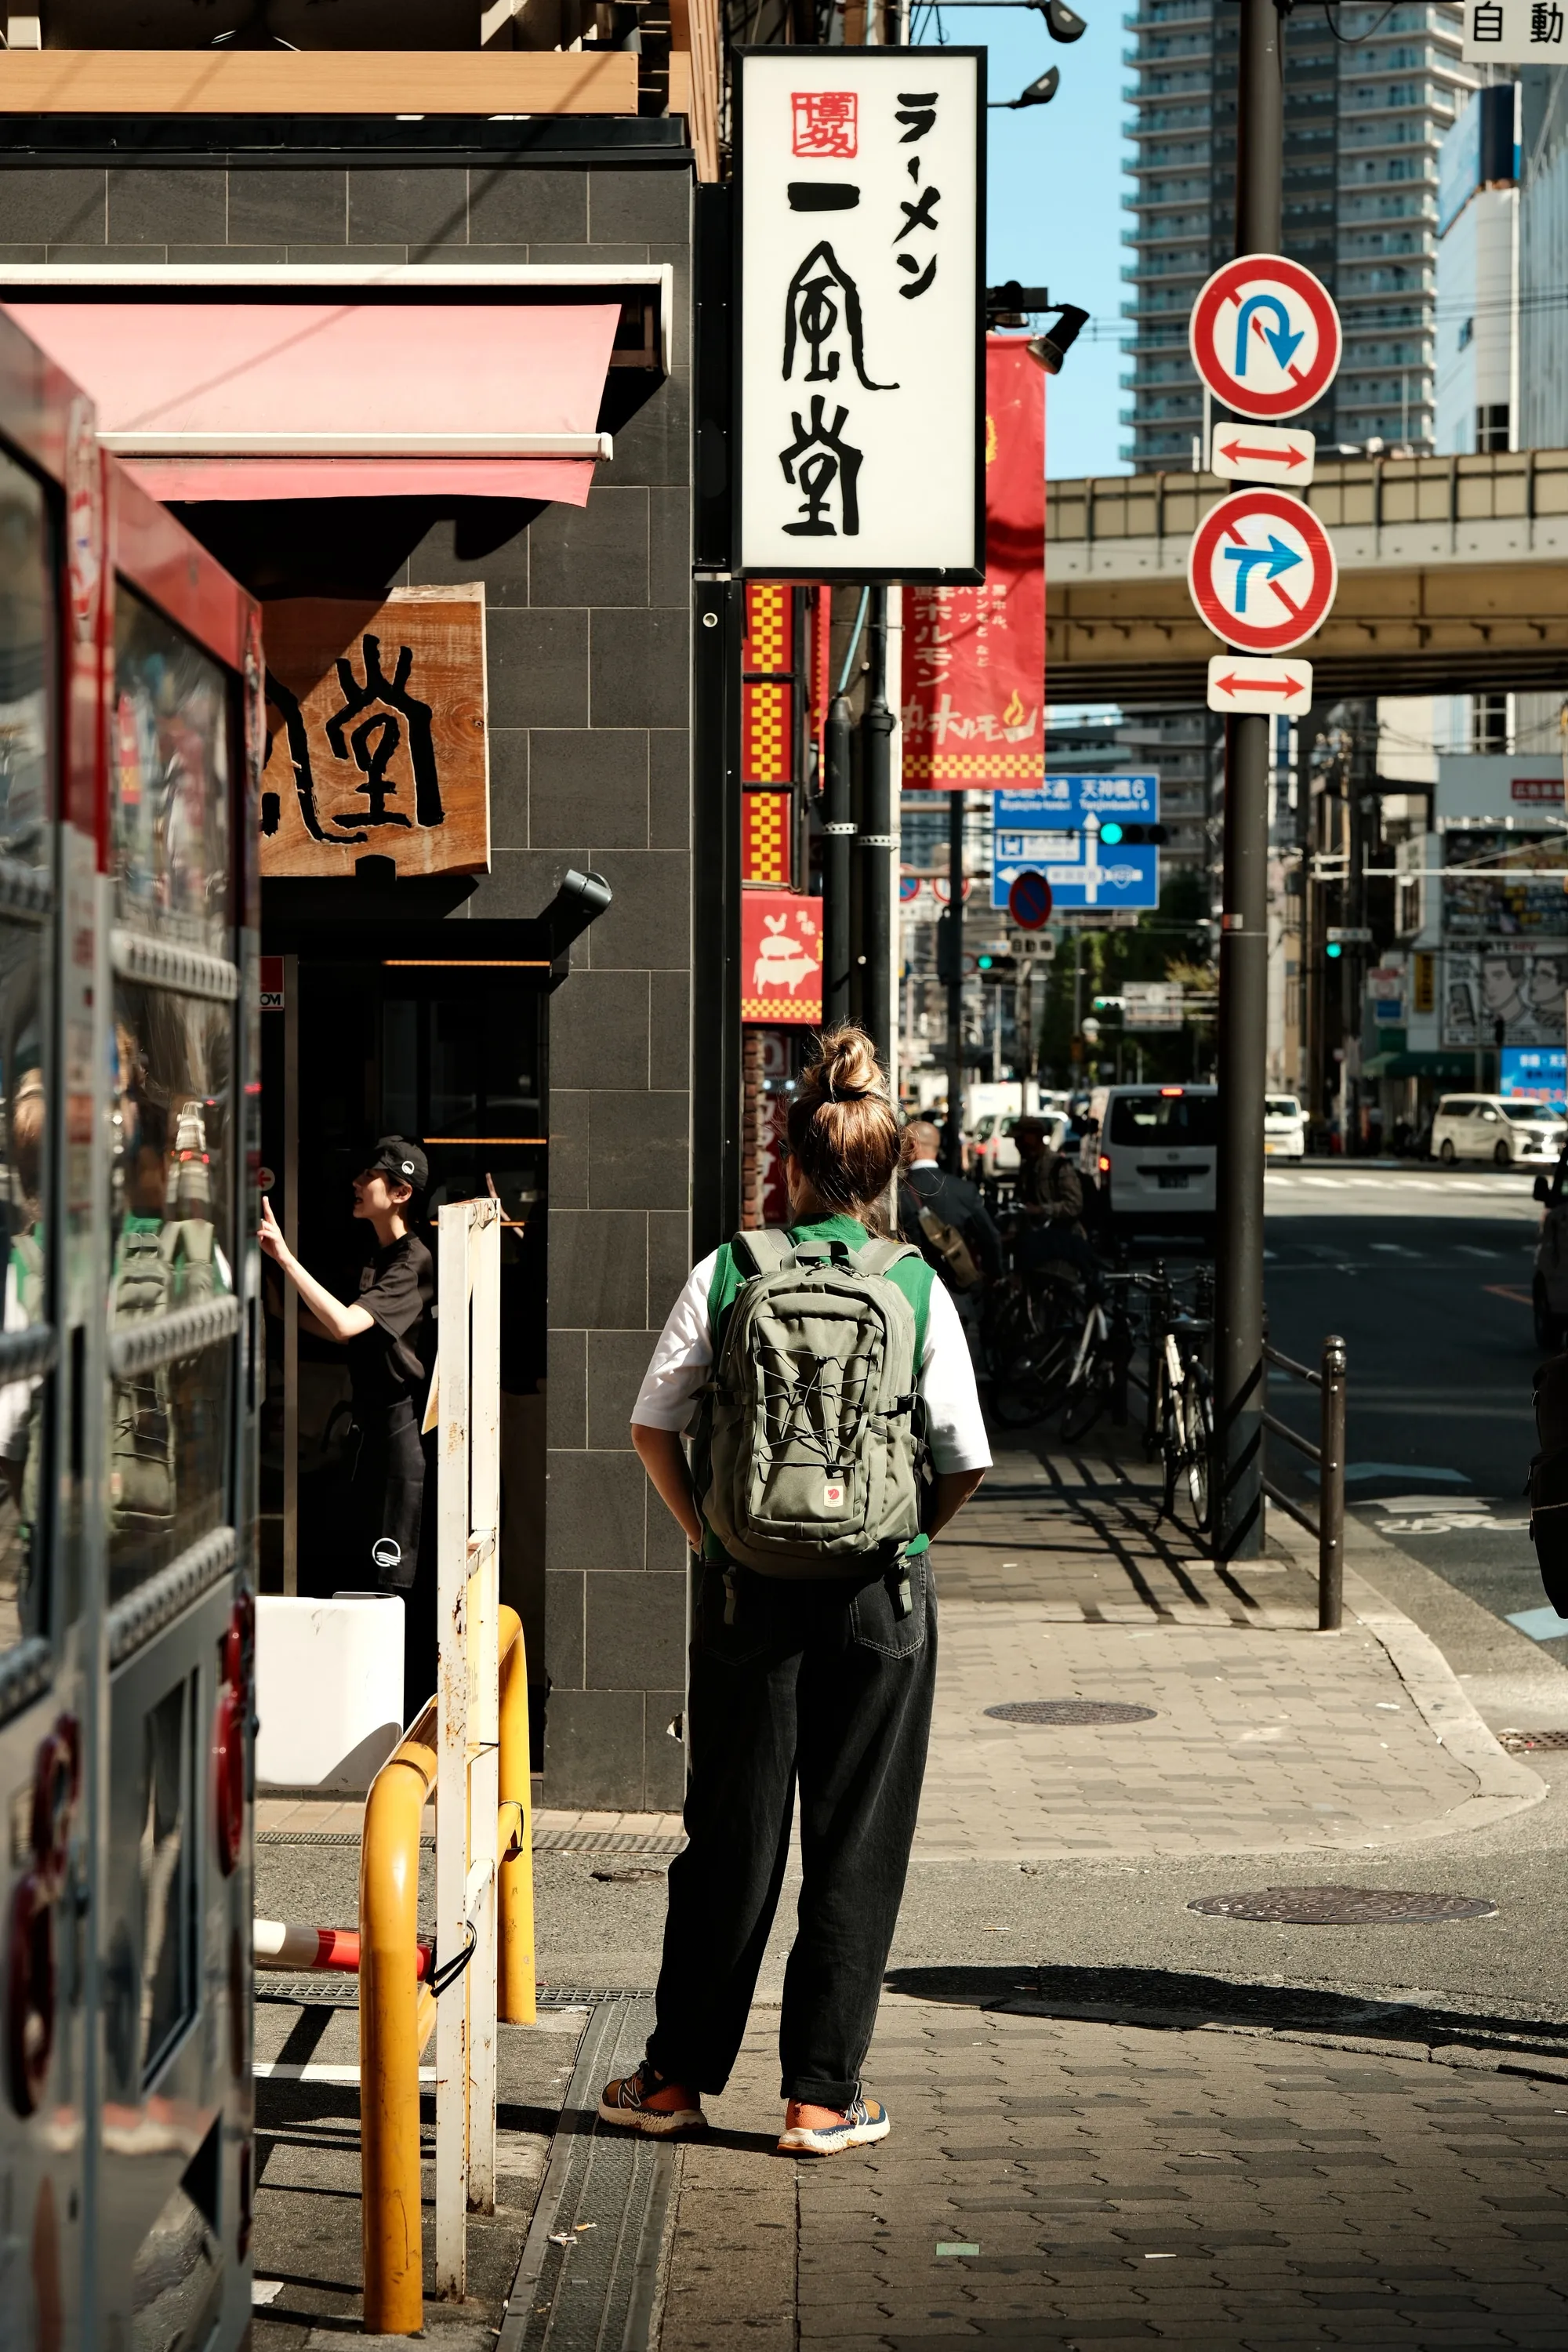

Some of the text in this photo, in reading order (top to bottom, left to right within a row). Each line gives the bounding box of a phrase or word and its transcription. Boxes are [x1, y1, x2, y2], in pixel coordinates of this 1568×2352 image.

[1473, 1, 1564, 43] 自動
[892, 92, 941, 299] ラーメン
[779, 182, 900, 536] 一風堂
